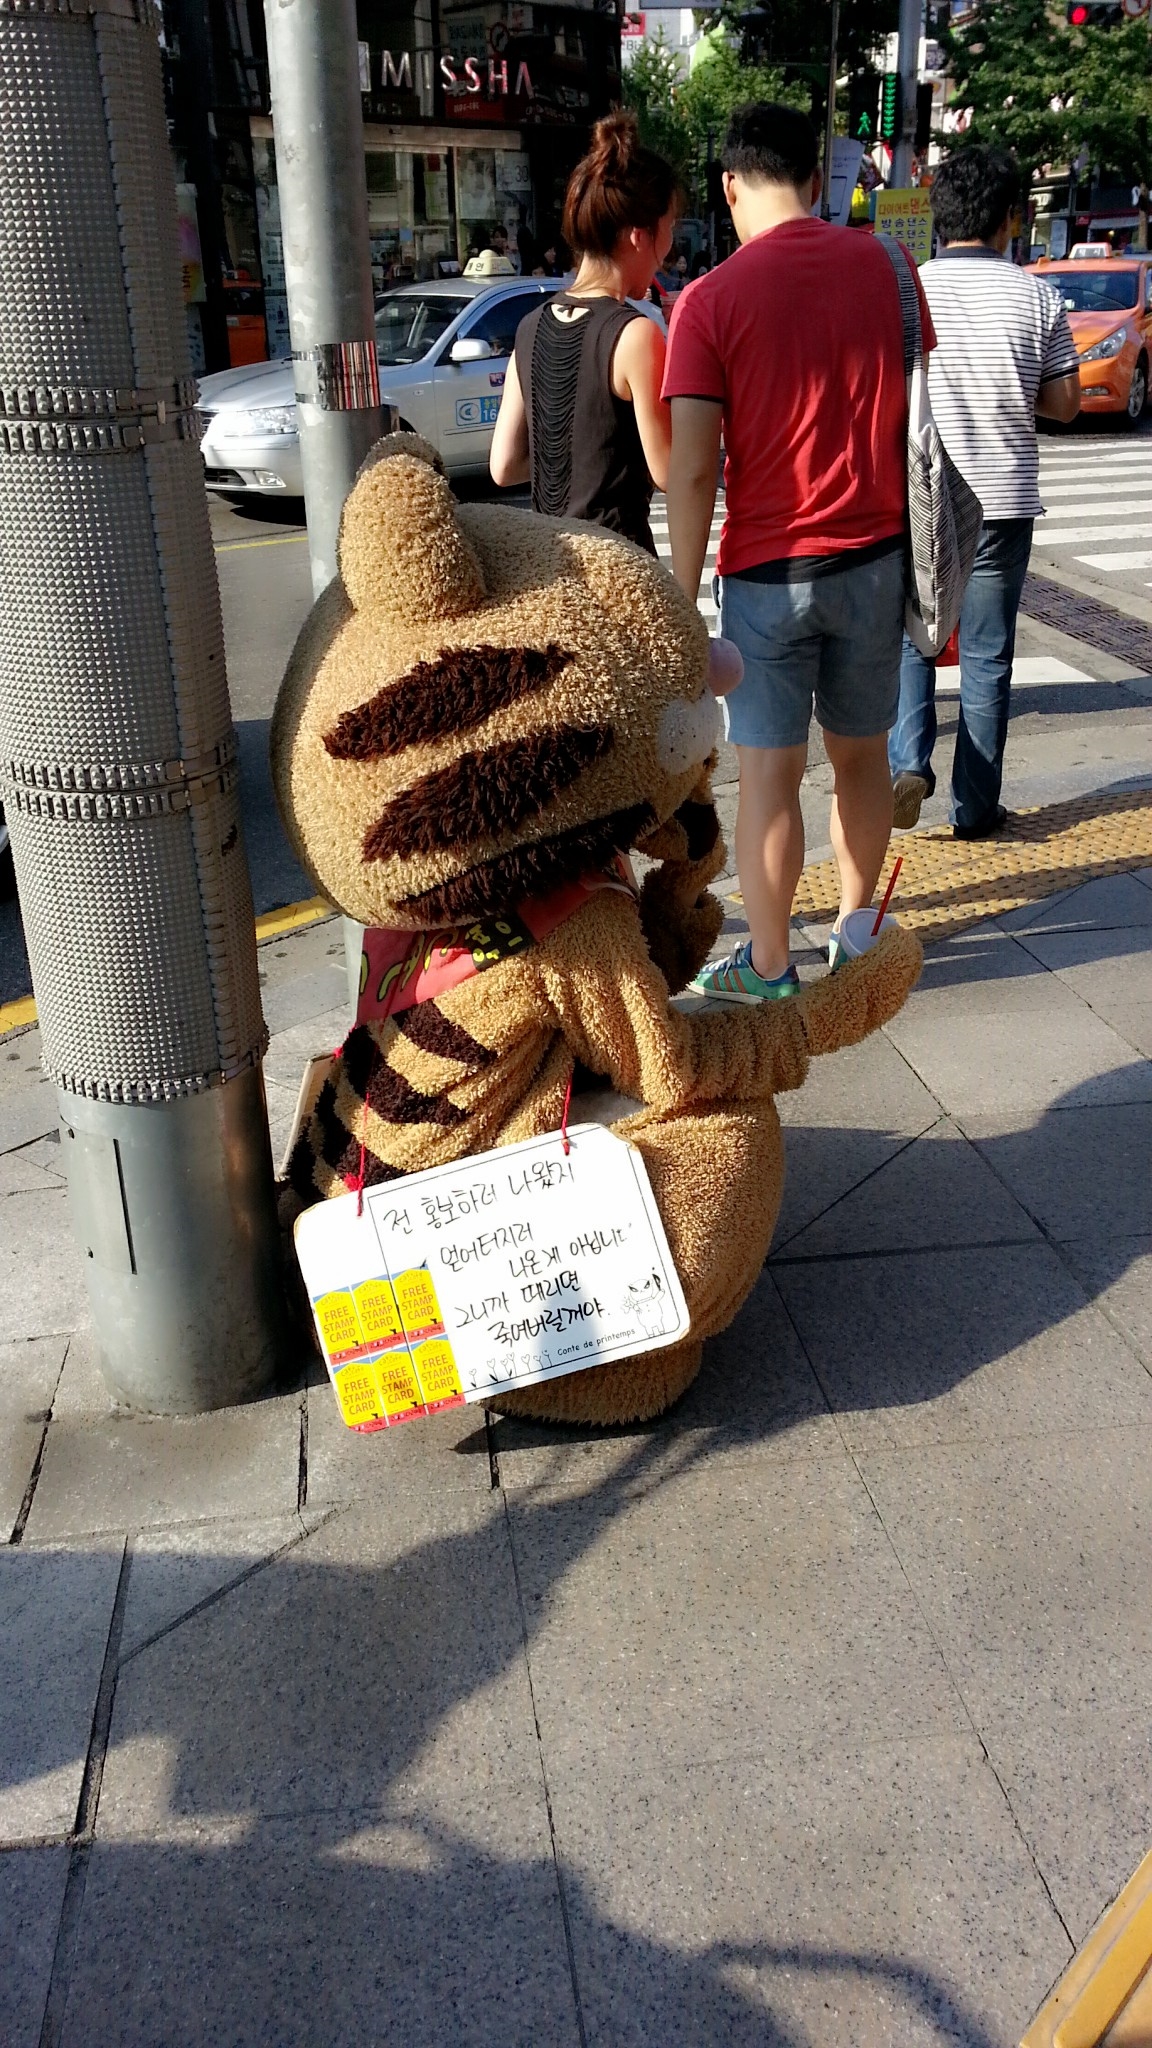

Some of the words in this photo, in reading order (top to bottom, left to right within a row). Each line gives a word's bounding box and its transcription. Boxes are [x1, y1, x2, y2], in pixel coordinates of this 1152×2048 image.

[381, 50, 535, 99] MISSHA
[383, 1208, 413, 1235] 전
[420, 1183, 498, 1229] 홍보하러
[440, 1222, 534, 1272] 얻어터지러
[402, 1284, 428, 1299] FREE
[455, 1291, 511, 1328] 그니까
[520, 1270, 582, 1303] 때리면
[362, 1294, 387, 1310] FREE
[402, 1294, 434, 1311] STAMP
[324, 1306, 349, 1322] FREE
[361, 1305, 393, 1322] STAMP
[408, 1305, 434, 1321] CARD
[324, 1316, 355, 1334] STAMP
[367, 1316, 394, 1331] CARD
[329, 1327, 356, 1343] CARD
[557, 1344, 580, 1357] Conte
[583, 1340, 594, 1349] de
[596, 1328, 636, 1347] printemps
[422, 1354, 448, 1370] FREE
[382, 1366, 408, 1382] FREE
[421, 1364, 454, 1382] STAMP
[343, 1377, 370, 1393] FREE
[381, 1377, 414, 1395] STAMP
[427, 1376, 455, 1392] CARD
[343, 1388, 375, 1406] STAMP
[387, 1388, 415, 1404] CARD
[349, 1400, 376, 1415] CARD
